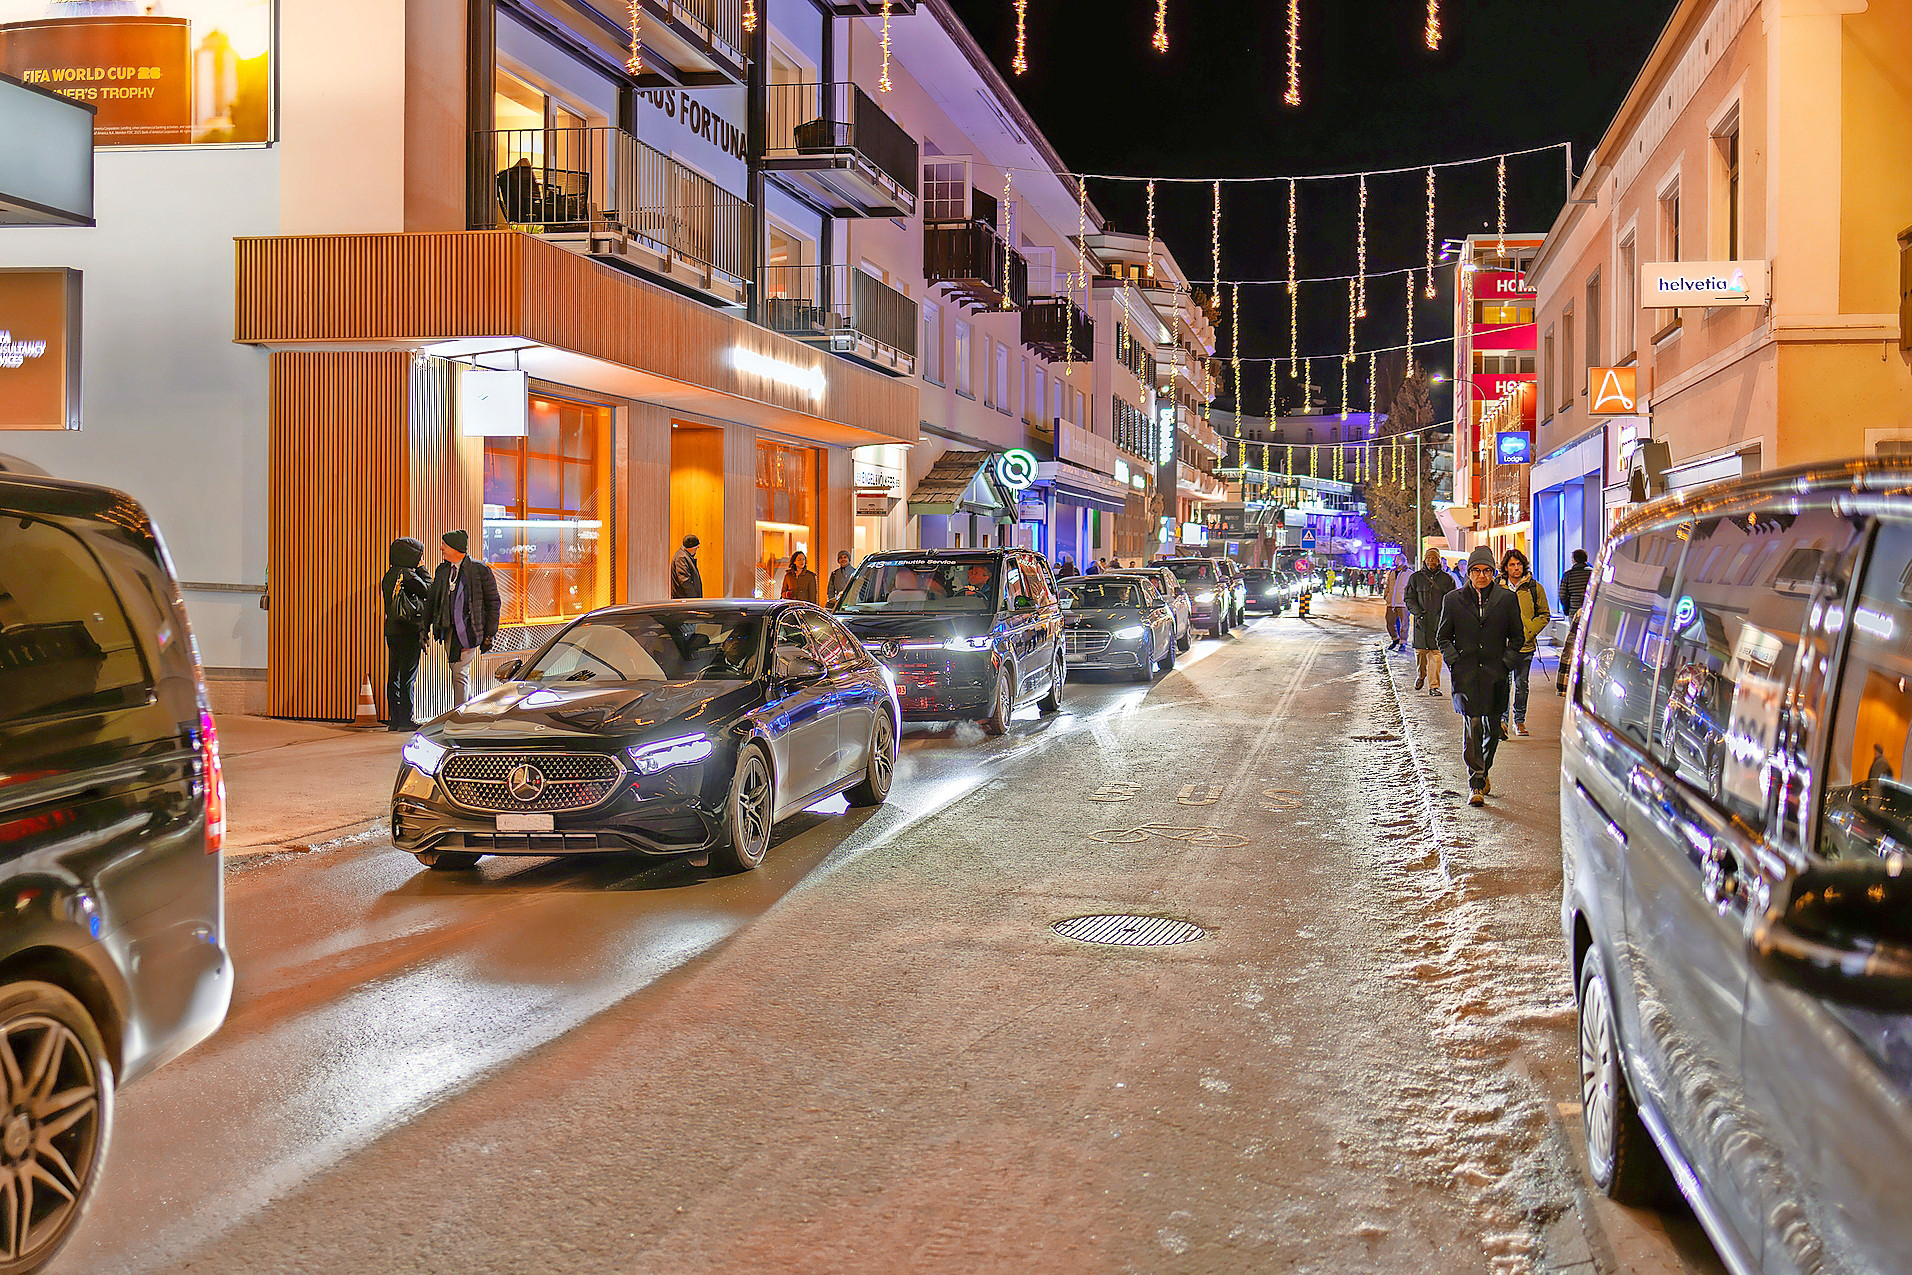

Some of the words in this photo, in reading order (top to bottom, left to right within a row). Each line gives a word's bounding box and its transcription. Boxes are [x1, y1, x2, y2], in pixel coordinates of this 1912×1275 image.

[23, 70, 50, 83] FIFA
[51, 68, 106, 82] WORLD
[107, 67, 136, 80] CUP
[100, 87, 155, 99] TROPHY
[680, 91, 748, 165] FORTUNA
[1659, 276, 1727, 291] helvetia
[1503, 455, 1524, 464] Lodge
